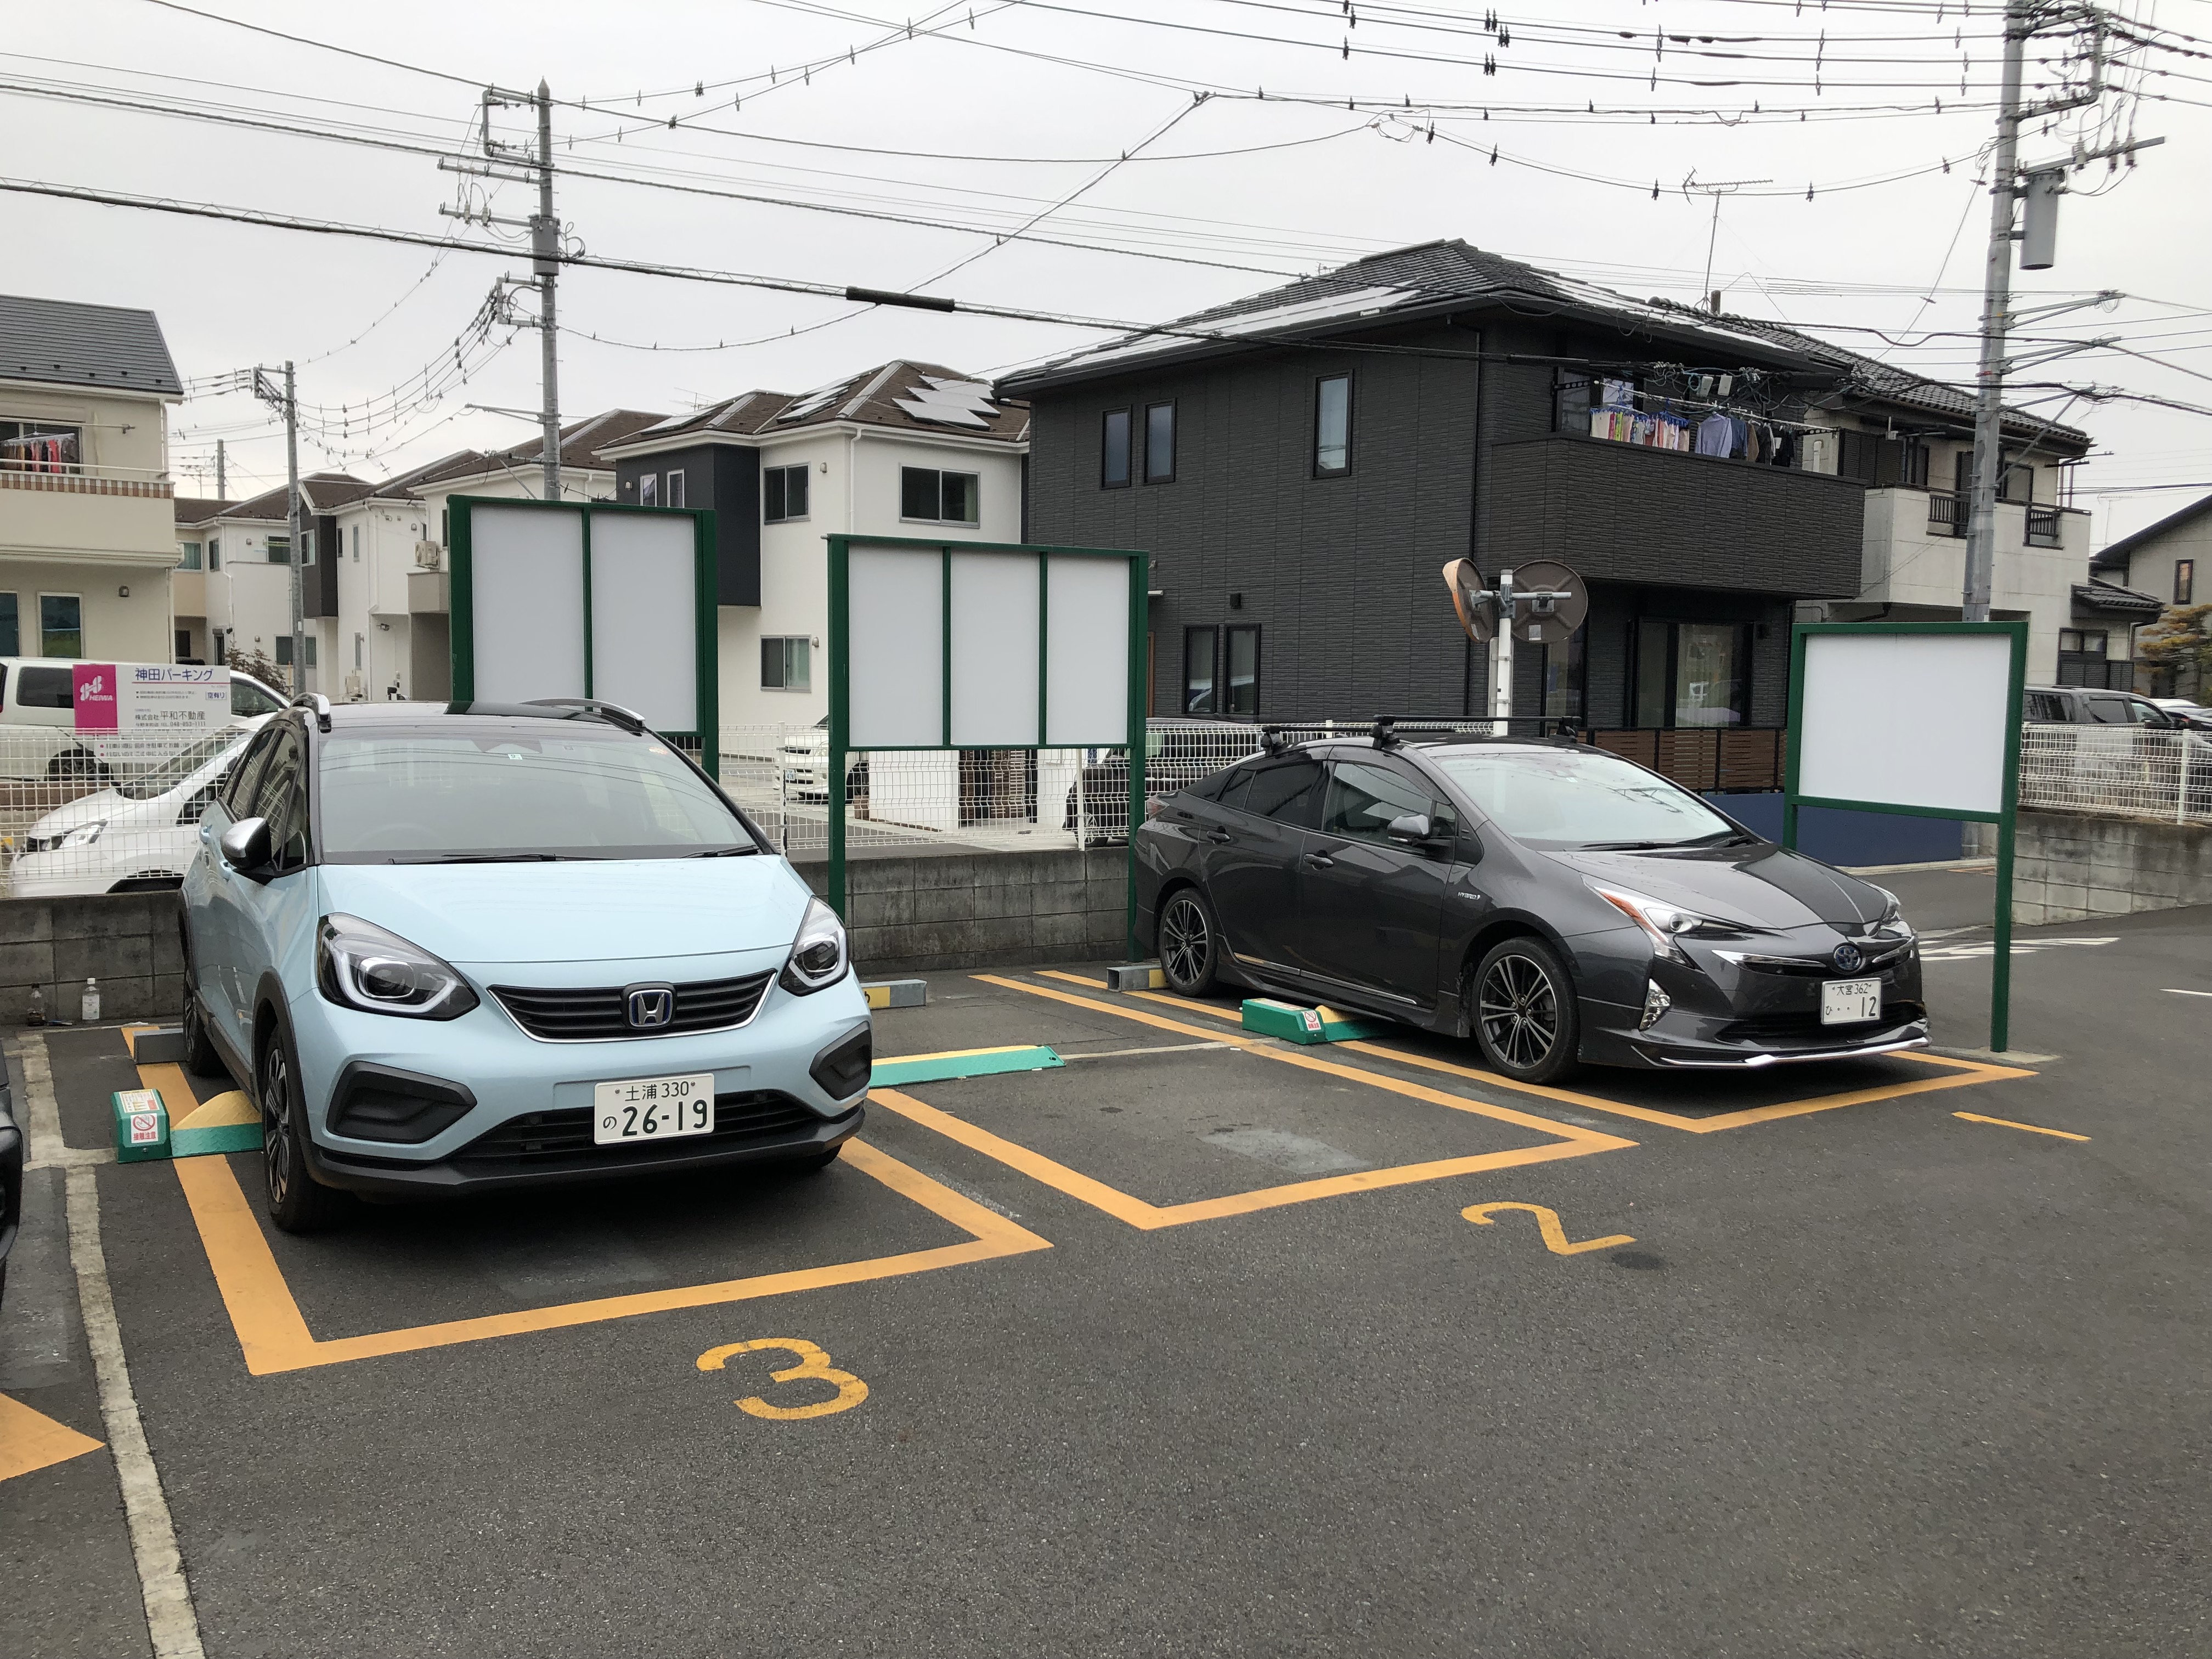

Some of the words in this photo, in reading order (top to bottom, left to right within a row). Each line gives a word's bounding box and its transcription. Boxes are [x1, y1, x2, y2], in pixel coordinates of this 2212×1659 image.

[135, 668, 213, 681] 神田パーキング
[1837, 985, 1853, 996] 大宮
[1854, 983, 1868, 994] 362
[1826, 1006, 1833, 1015] ひ
[625, 1084, 657, 1102] 土浦
[661, 1081, 690, 1098] 330
[603, 1116, 617, 1130] の
[622, 1099, 707, 1137] 26-19
[1461, 1201, 1637, 1255] 2
[696, 1338, 868, 1420] 3
